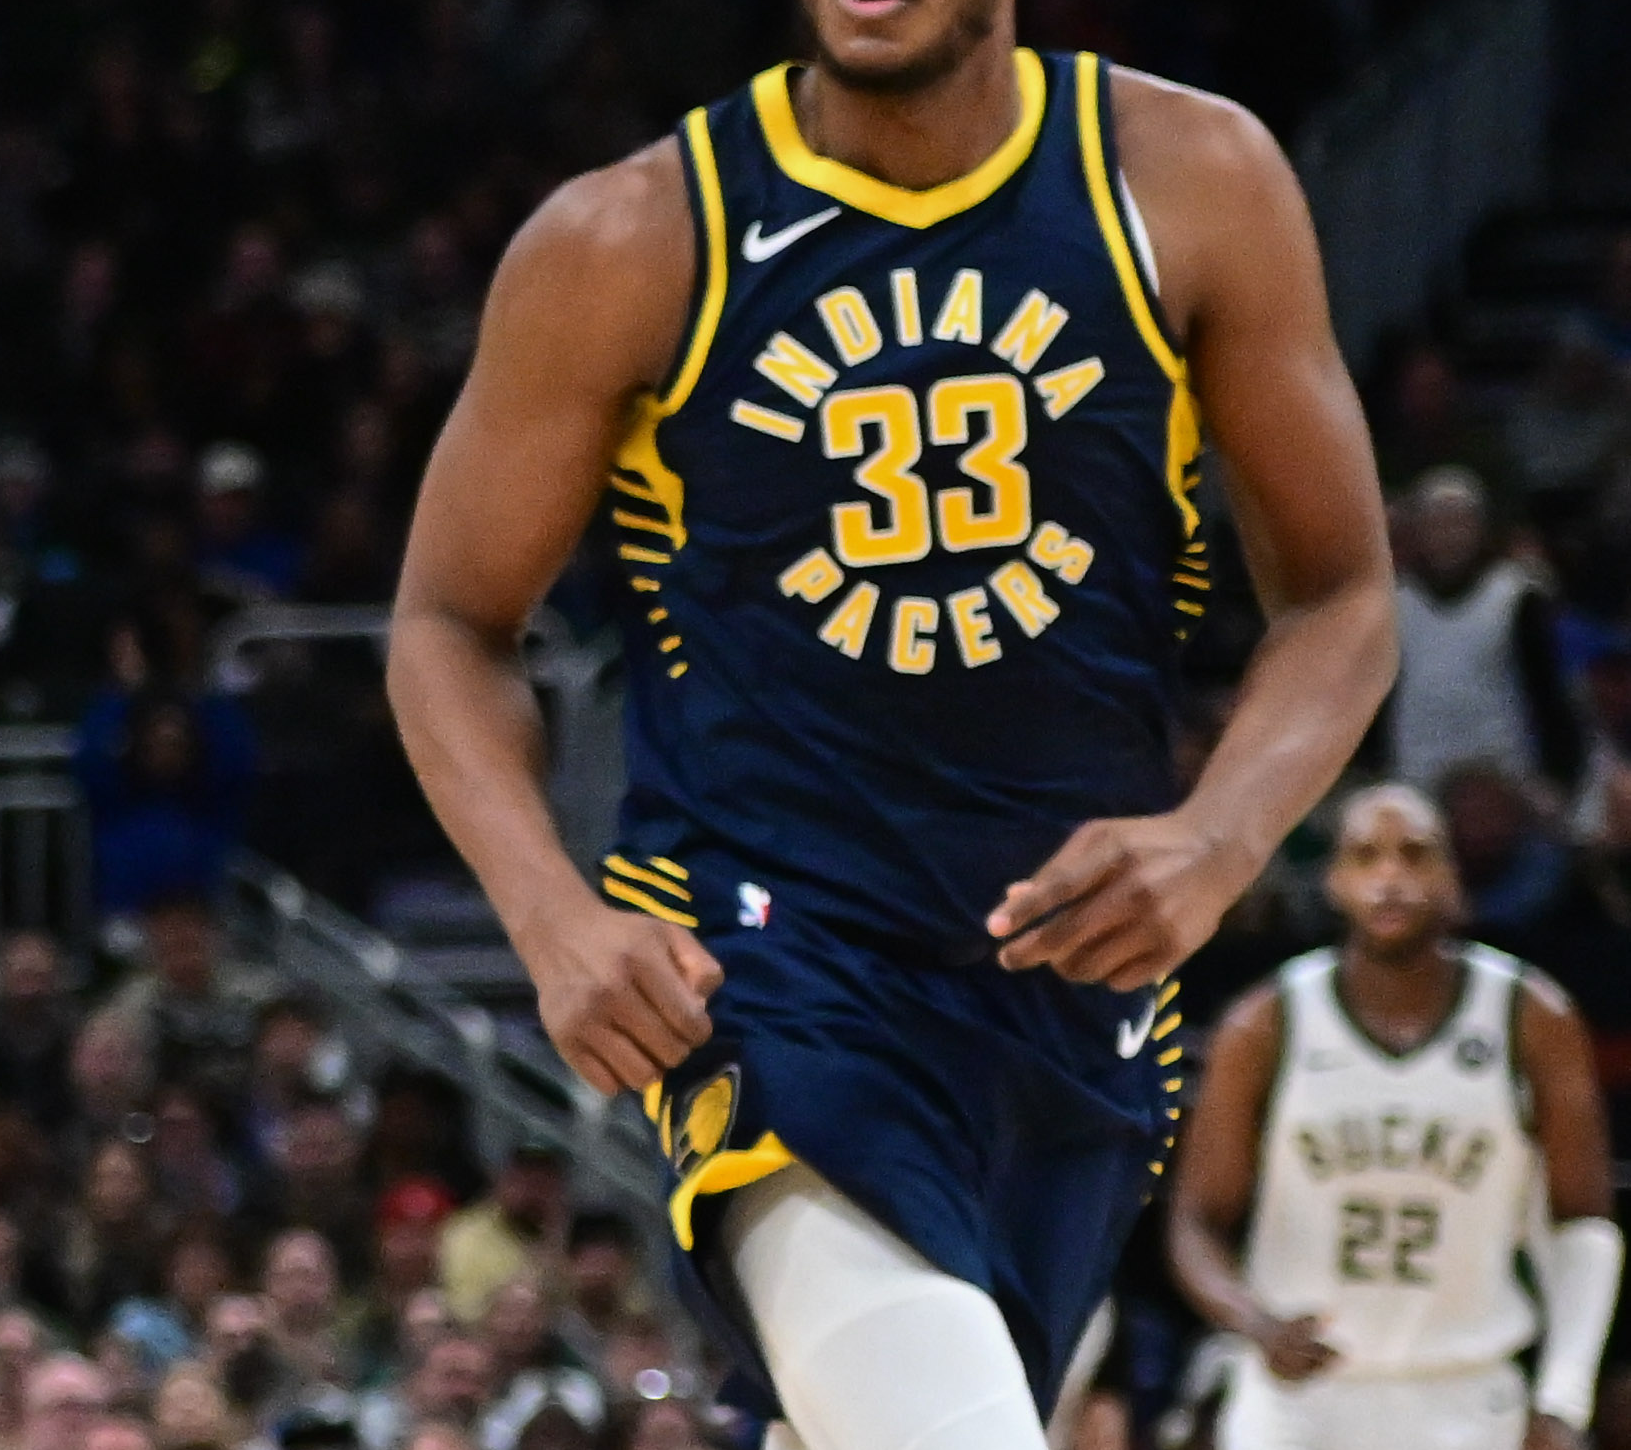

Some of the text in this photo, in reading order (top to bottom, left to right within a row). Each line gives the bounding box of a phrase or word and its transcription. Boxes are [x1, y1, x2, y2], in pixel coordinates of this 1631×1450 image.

[730, 267, 1105, 443] INDIANA
[820, 373, 1032, 568] 33
[777, 521, 1096, 675] PACERS
[1336, 1196, 1439, 1286] 22
